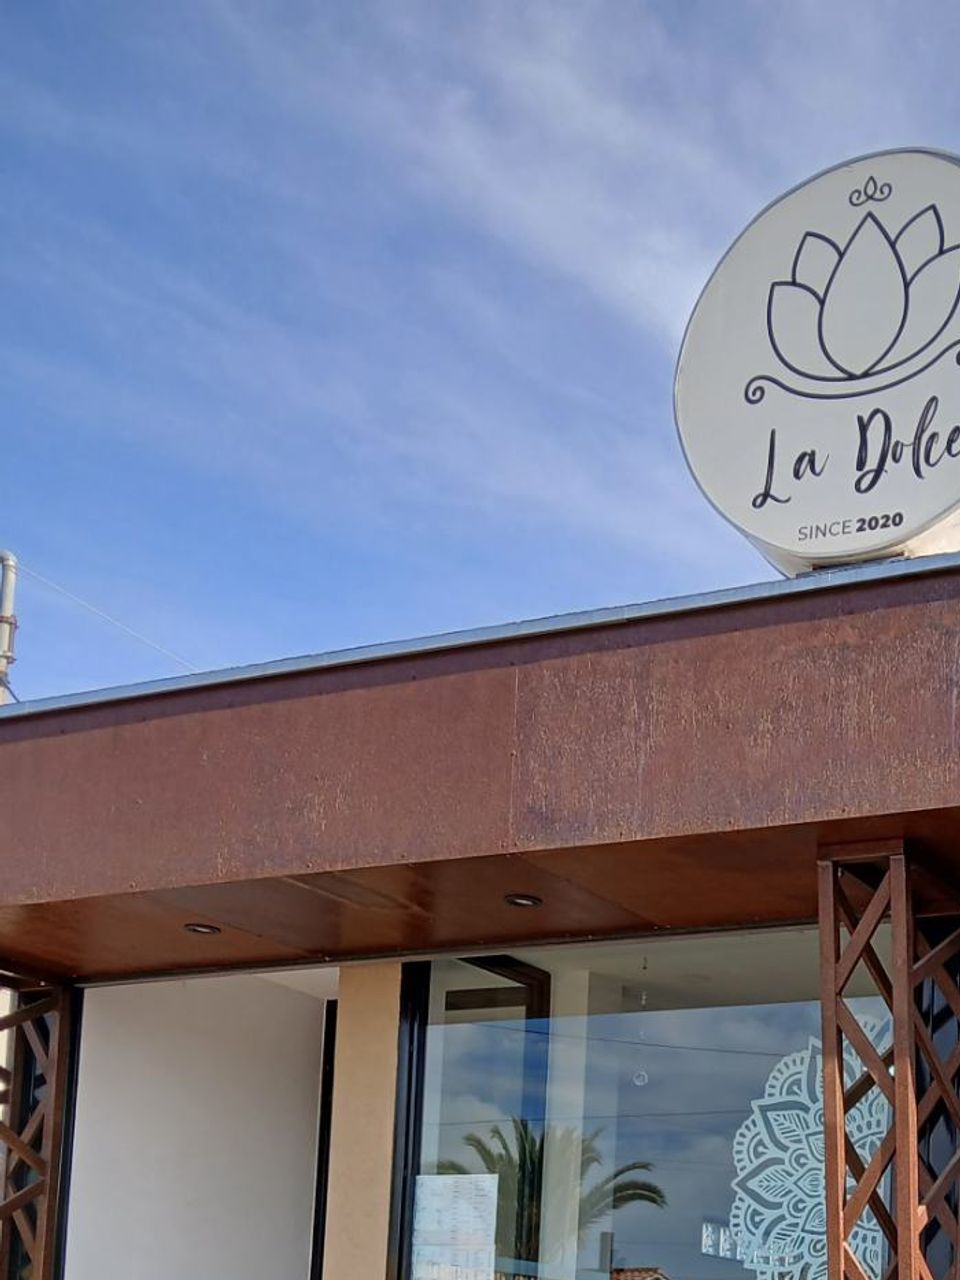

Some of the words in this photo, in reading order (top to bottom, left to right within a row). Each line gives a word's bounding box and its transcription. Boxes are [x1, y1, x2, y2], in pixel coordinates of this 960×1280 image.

[752, 428, 829, 508] La
[797, 519, 852, 541] SINCE
[855, 512, 904, 533] 2020
